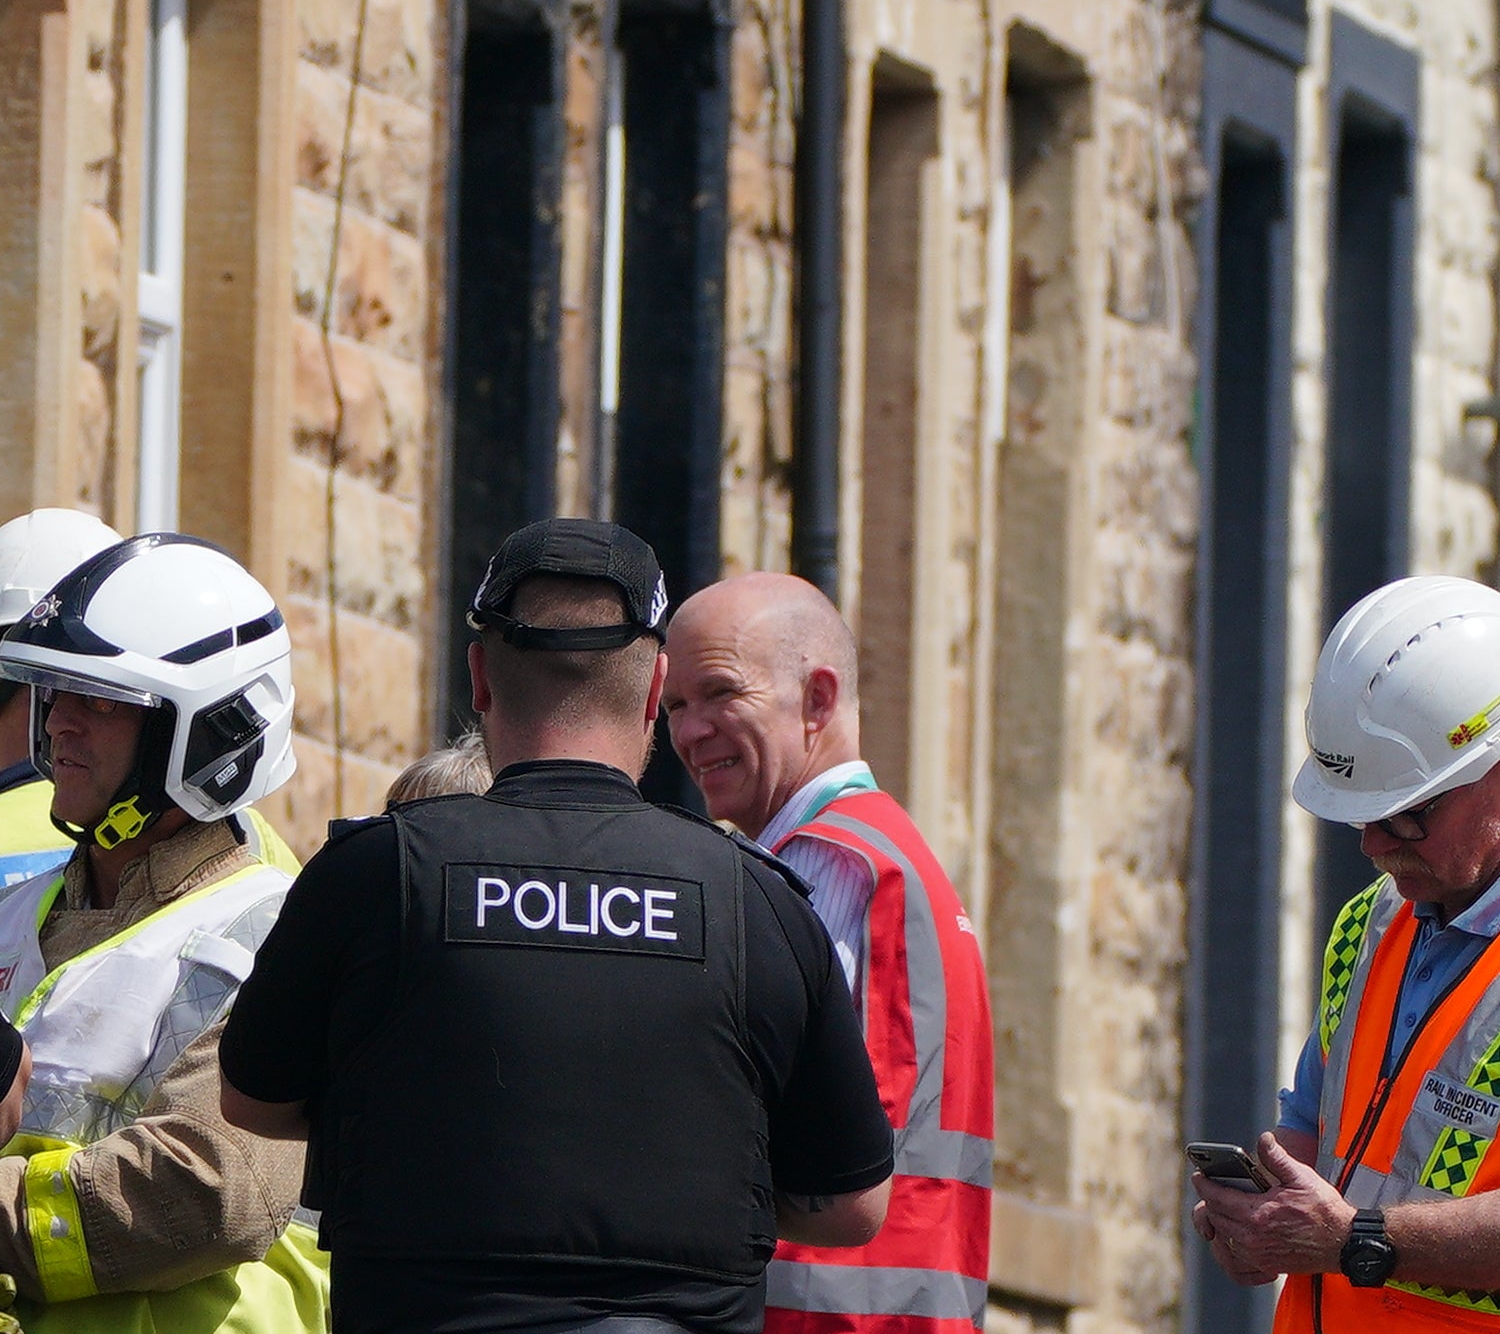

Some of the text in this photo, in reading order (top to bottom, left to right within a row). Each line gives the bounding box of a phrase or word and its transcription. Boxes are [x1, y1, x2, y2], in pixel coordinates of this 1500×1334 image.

[476, 877, 678, 941] POLICE
[1425, 1078, 1499, 1117] RAIL INCIDENT
[1434, 1098, 1474, 1125] OFFICER
